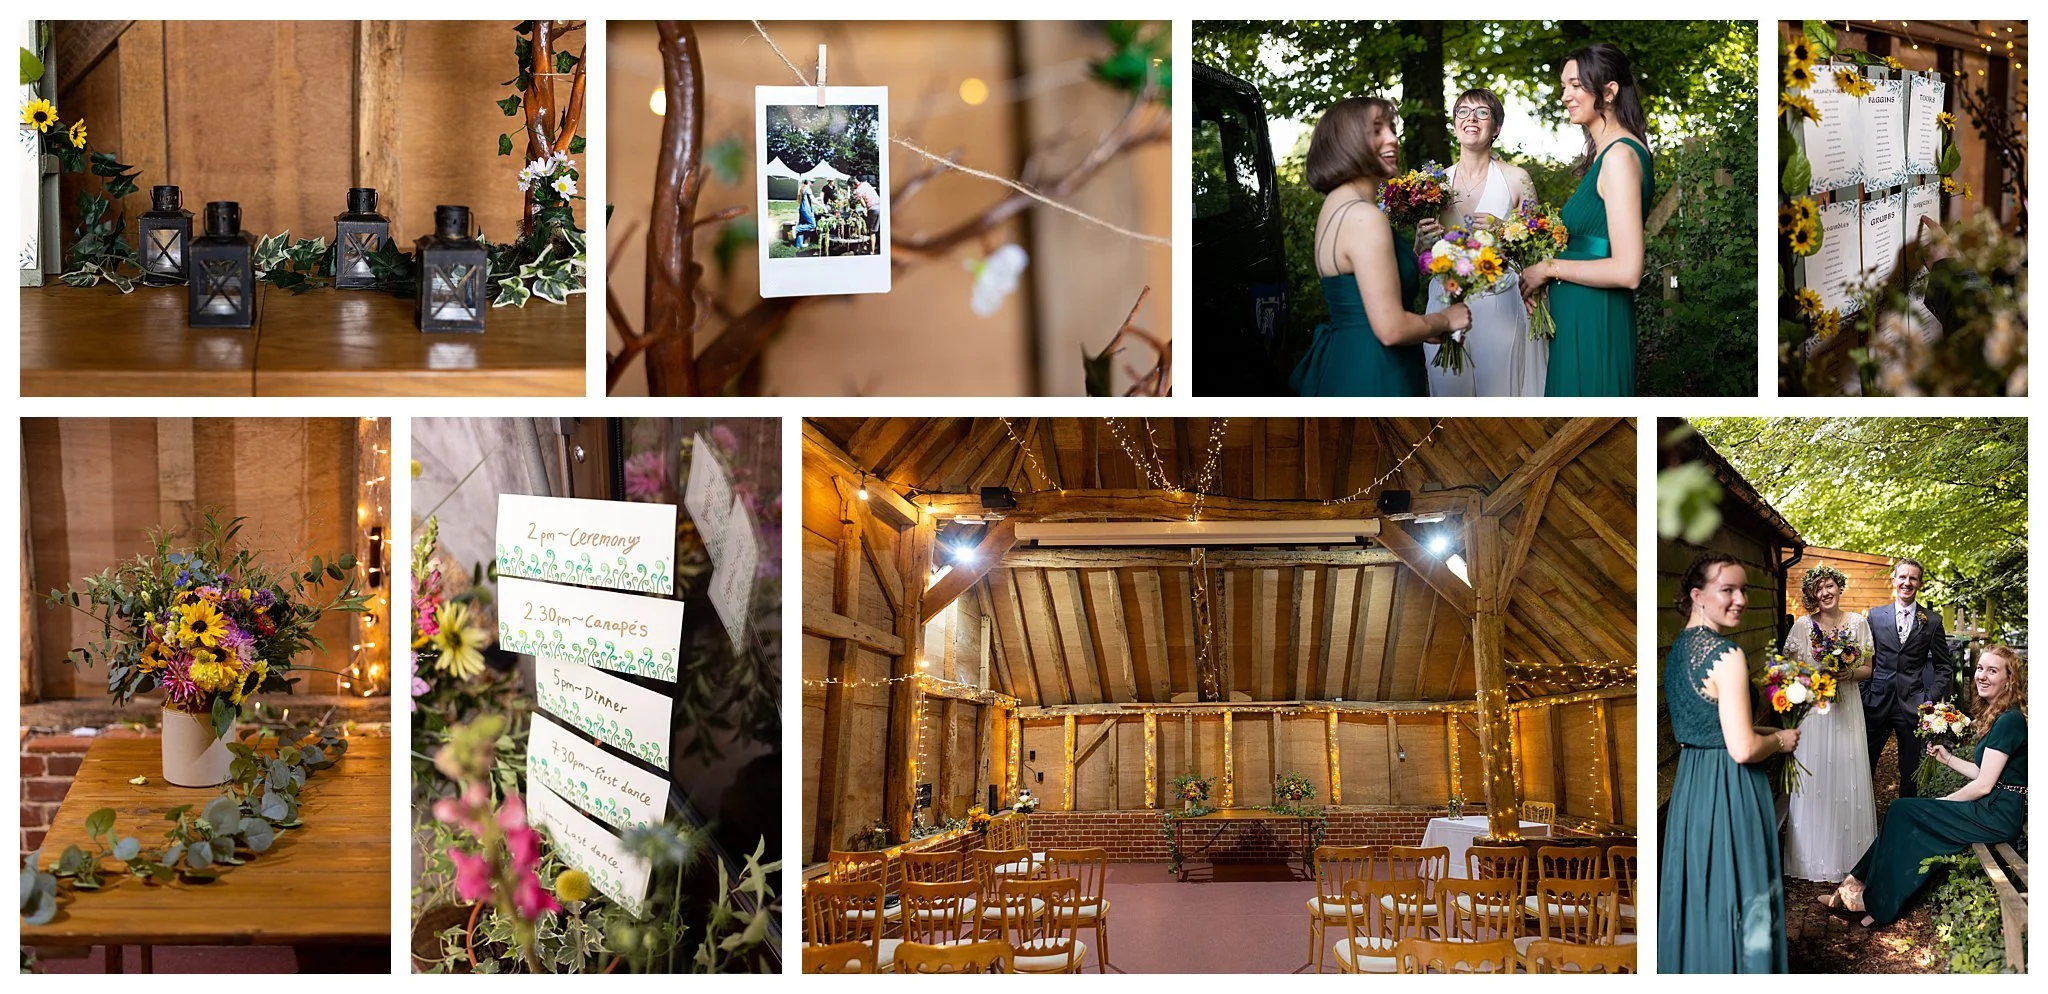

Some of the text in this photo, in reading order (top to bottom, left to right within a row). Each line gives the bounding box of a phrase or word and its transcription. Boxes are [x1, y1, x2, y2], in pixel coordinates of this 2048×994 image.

[585, 686, 628, 714] Dinner
[595, 766, 618, 787] First
[621, 781, 651, 806] dance
[564, 824, 587, 847] Last
